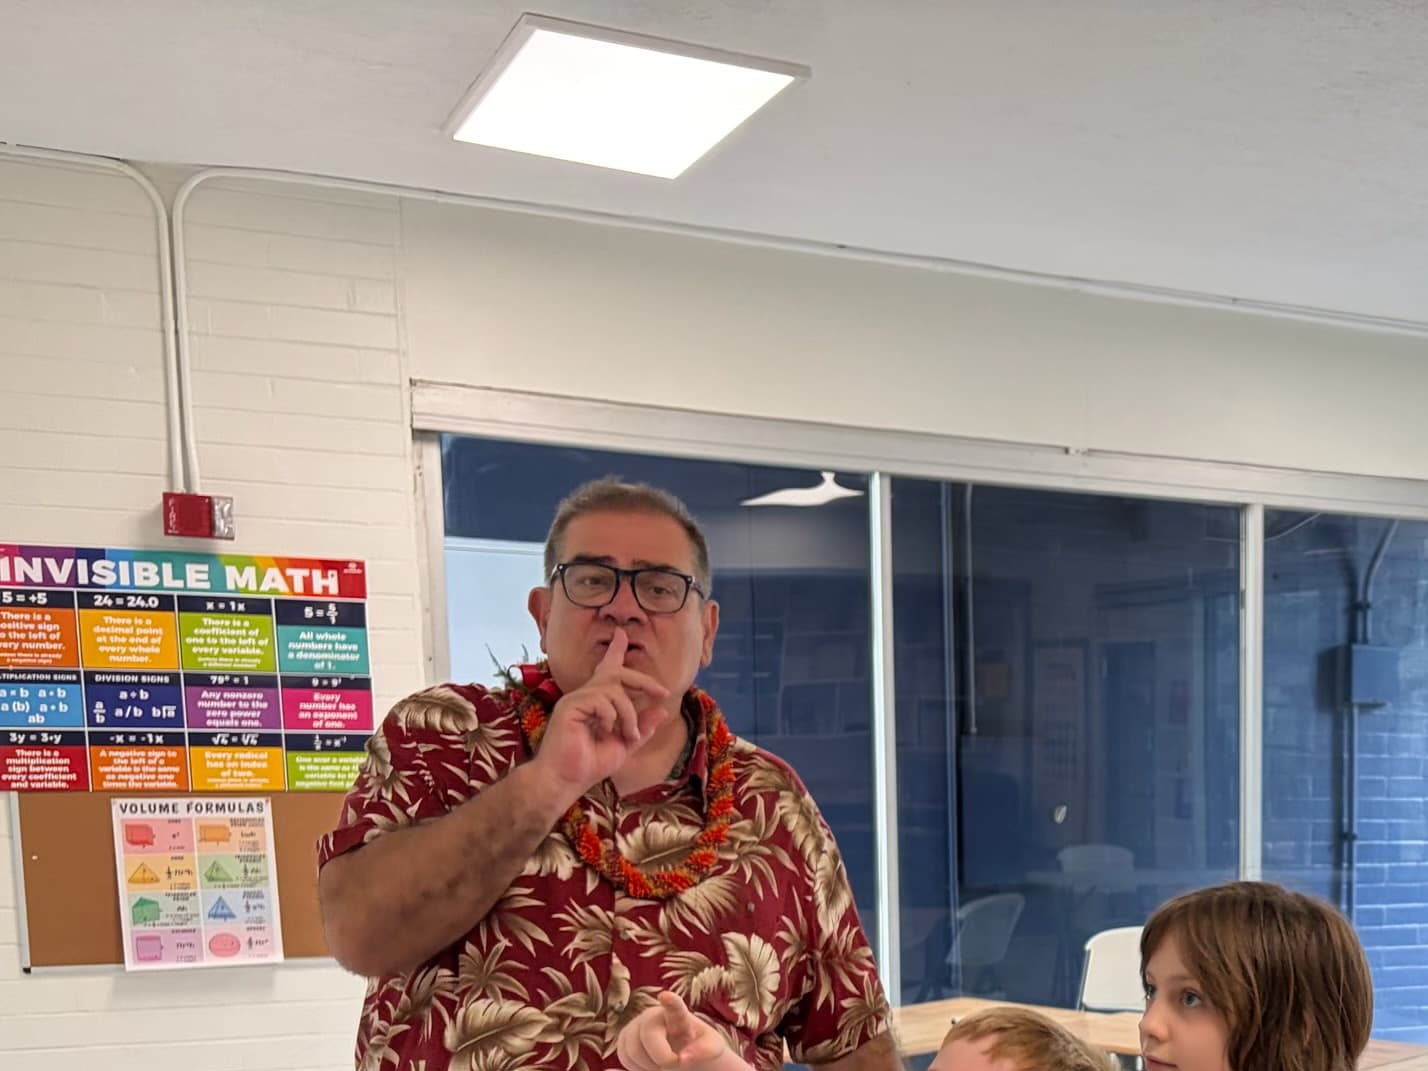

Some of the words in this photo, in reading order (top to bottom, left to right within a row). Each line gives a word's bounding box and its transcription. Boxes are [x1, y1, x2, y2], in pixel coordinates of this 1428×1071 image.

[0, 555, 211, 590] INVISIBLE
[224, 565, 339, 596] MATH
[2, 591, 14, 605] 5
[29, 592, 48, 606] +5
[94, 594, 113, 607] 24
[127, 596, 160, 609] 24.0
[1, 611, 30, 621] There
[33, 611, 42, 621] is
[103, 615, 132, 625] There
[134, 616, 143, 625] is
[202, 617, 230, 626] There
[232, 617, 241, 626] is
[0, 621, 36, 631] ositive
[37, 622, 60, 633] sign
[93, 625, 134, 634] decimal
[136, 626, 164, 636] point
[248, 627, 259, 637] of
[8, 631, 27, 639] the
[29, 631, 47, 640] left
[49, 631, 61, 641] of
[110, 635, 127, 644] the
[129, 635, 148, 644] end
[151, 635, 162, 645] of
[207, 636, 217, 645] to
[219, 636, 237, 645] the
[239, 636, 256, 645] left
[257, 637, 269, 646] of
[299, 631, 314, 640] All
[316, 631, 347, 641] whole
[0, 641, 21, 651] ery
[22, 641, 66, 651] number.
[98, 645, 126, 655] every
[192, 646, 219, 656] every
[335, 642, 359, 651] have
[0, 673, 52, 681] TIPLICATION
[95, 674, 139, 683] DIVISION
[141, 675, 170, 684] SIGNS
[201, 690, 221, 699] Any
[313, 692, 341, 702] Every
[12, 702, 30, 713] (b)
[238, 700, 249, 709] to
[251, 700, 268, 709] the
[9, 733, 26, 744] 3y
[16, 749, 42, 757] There
[119, 802, 180, 814] VOLUME
[186, 801, 265, 814] FORMULAS
